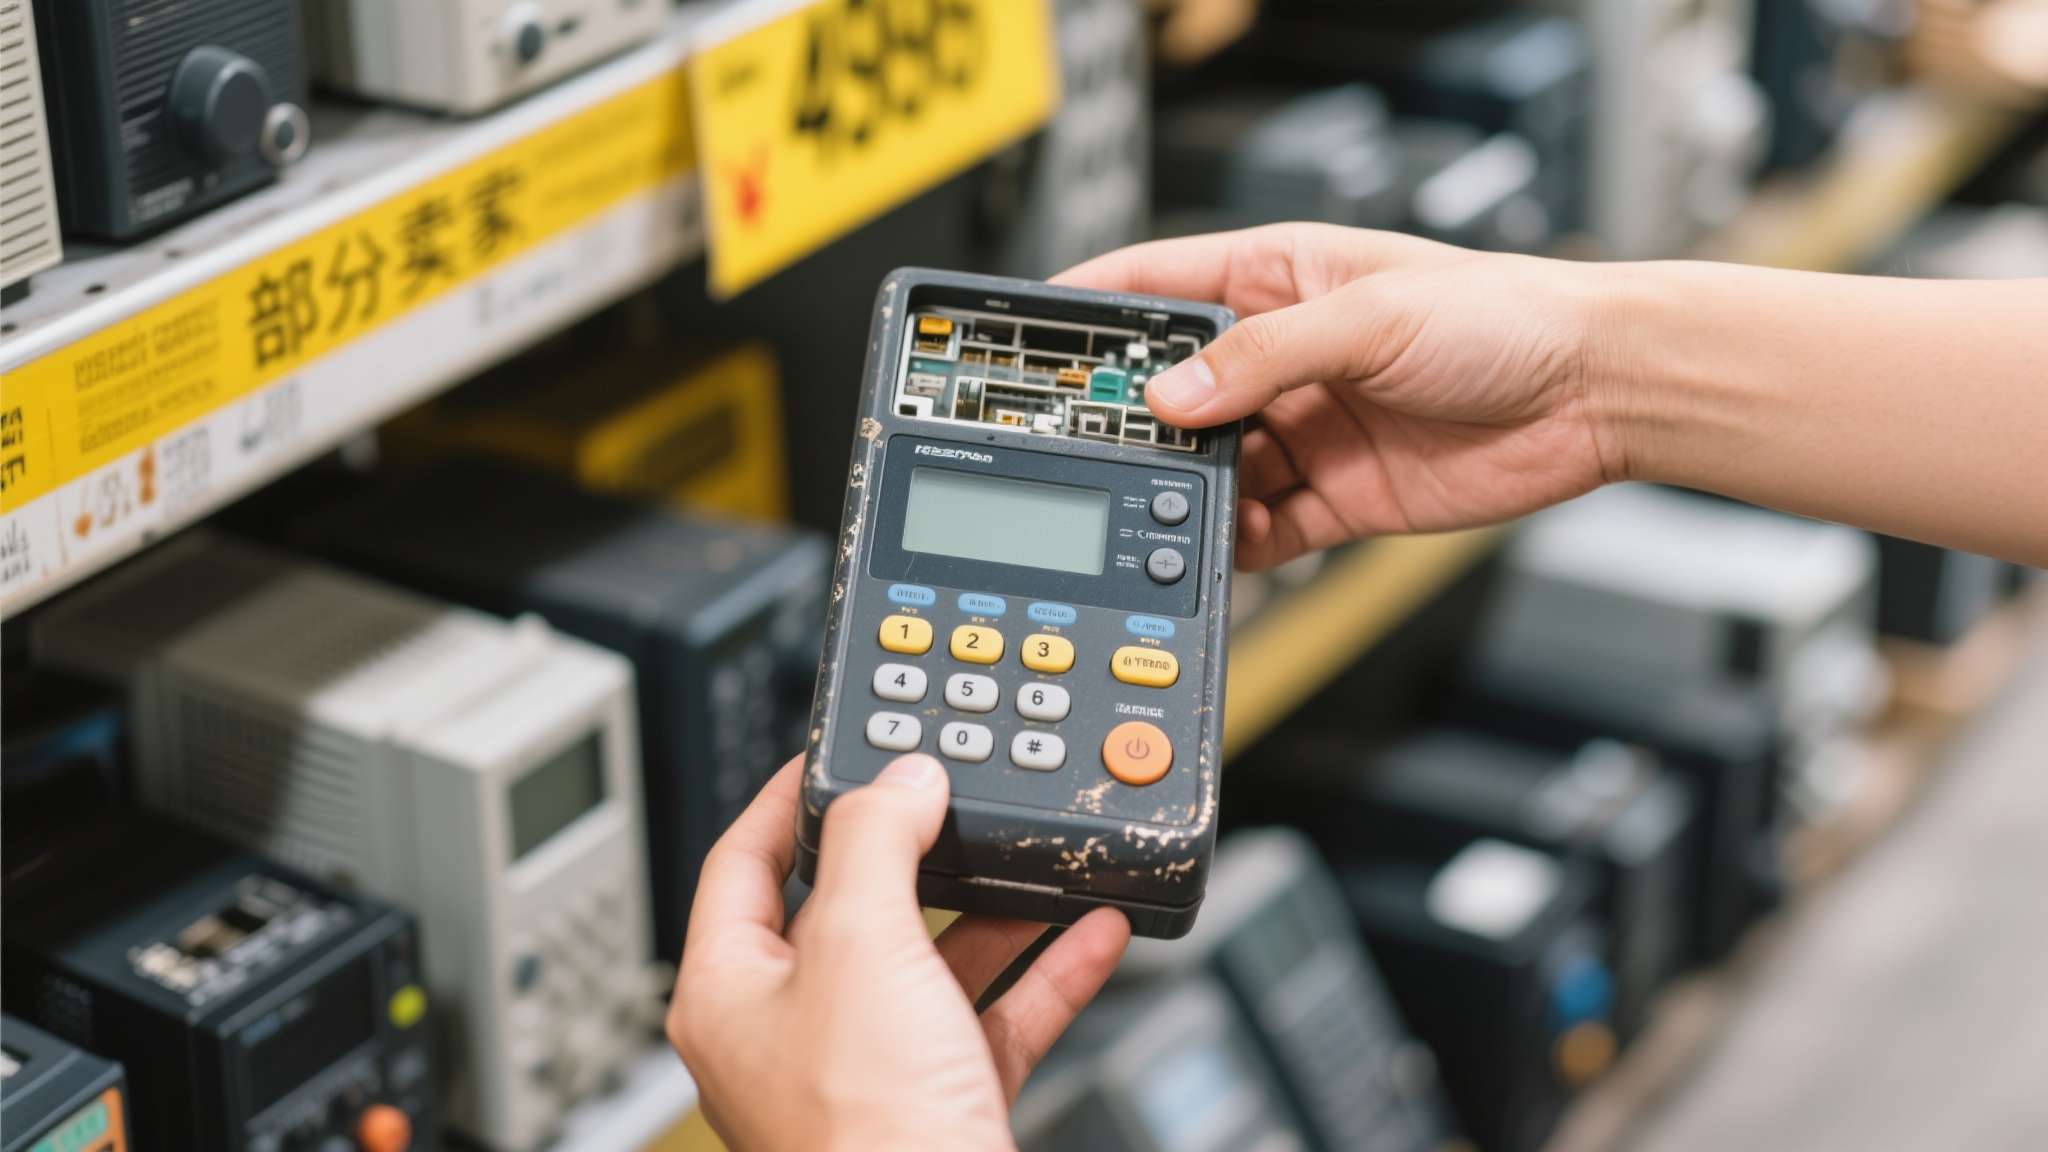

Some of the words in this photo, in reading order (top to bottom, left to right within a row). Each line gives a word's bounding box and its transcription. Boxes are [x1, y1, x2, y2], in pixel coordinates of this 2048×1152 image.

[901, 623, 909, 639] 1
[966, 632, 979, 649] 2
[1038, 641, 1050, 658] 3
[894, 672, 906, 687] 4
[962, 681, 974, 697] 5
[1031, 690, 1044, 706] 6
[888, 719, 901, 736] 7
[956, 730, 968, 746] 0
[1027, 739, 1042, 754] #
